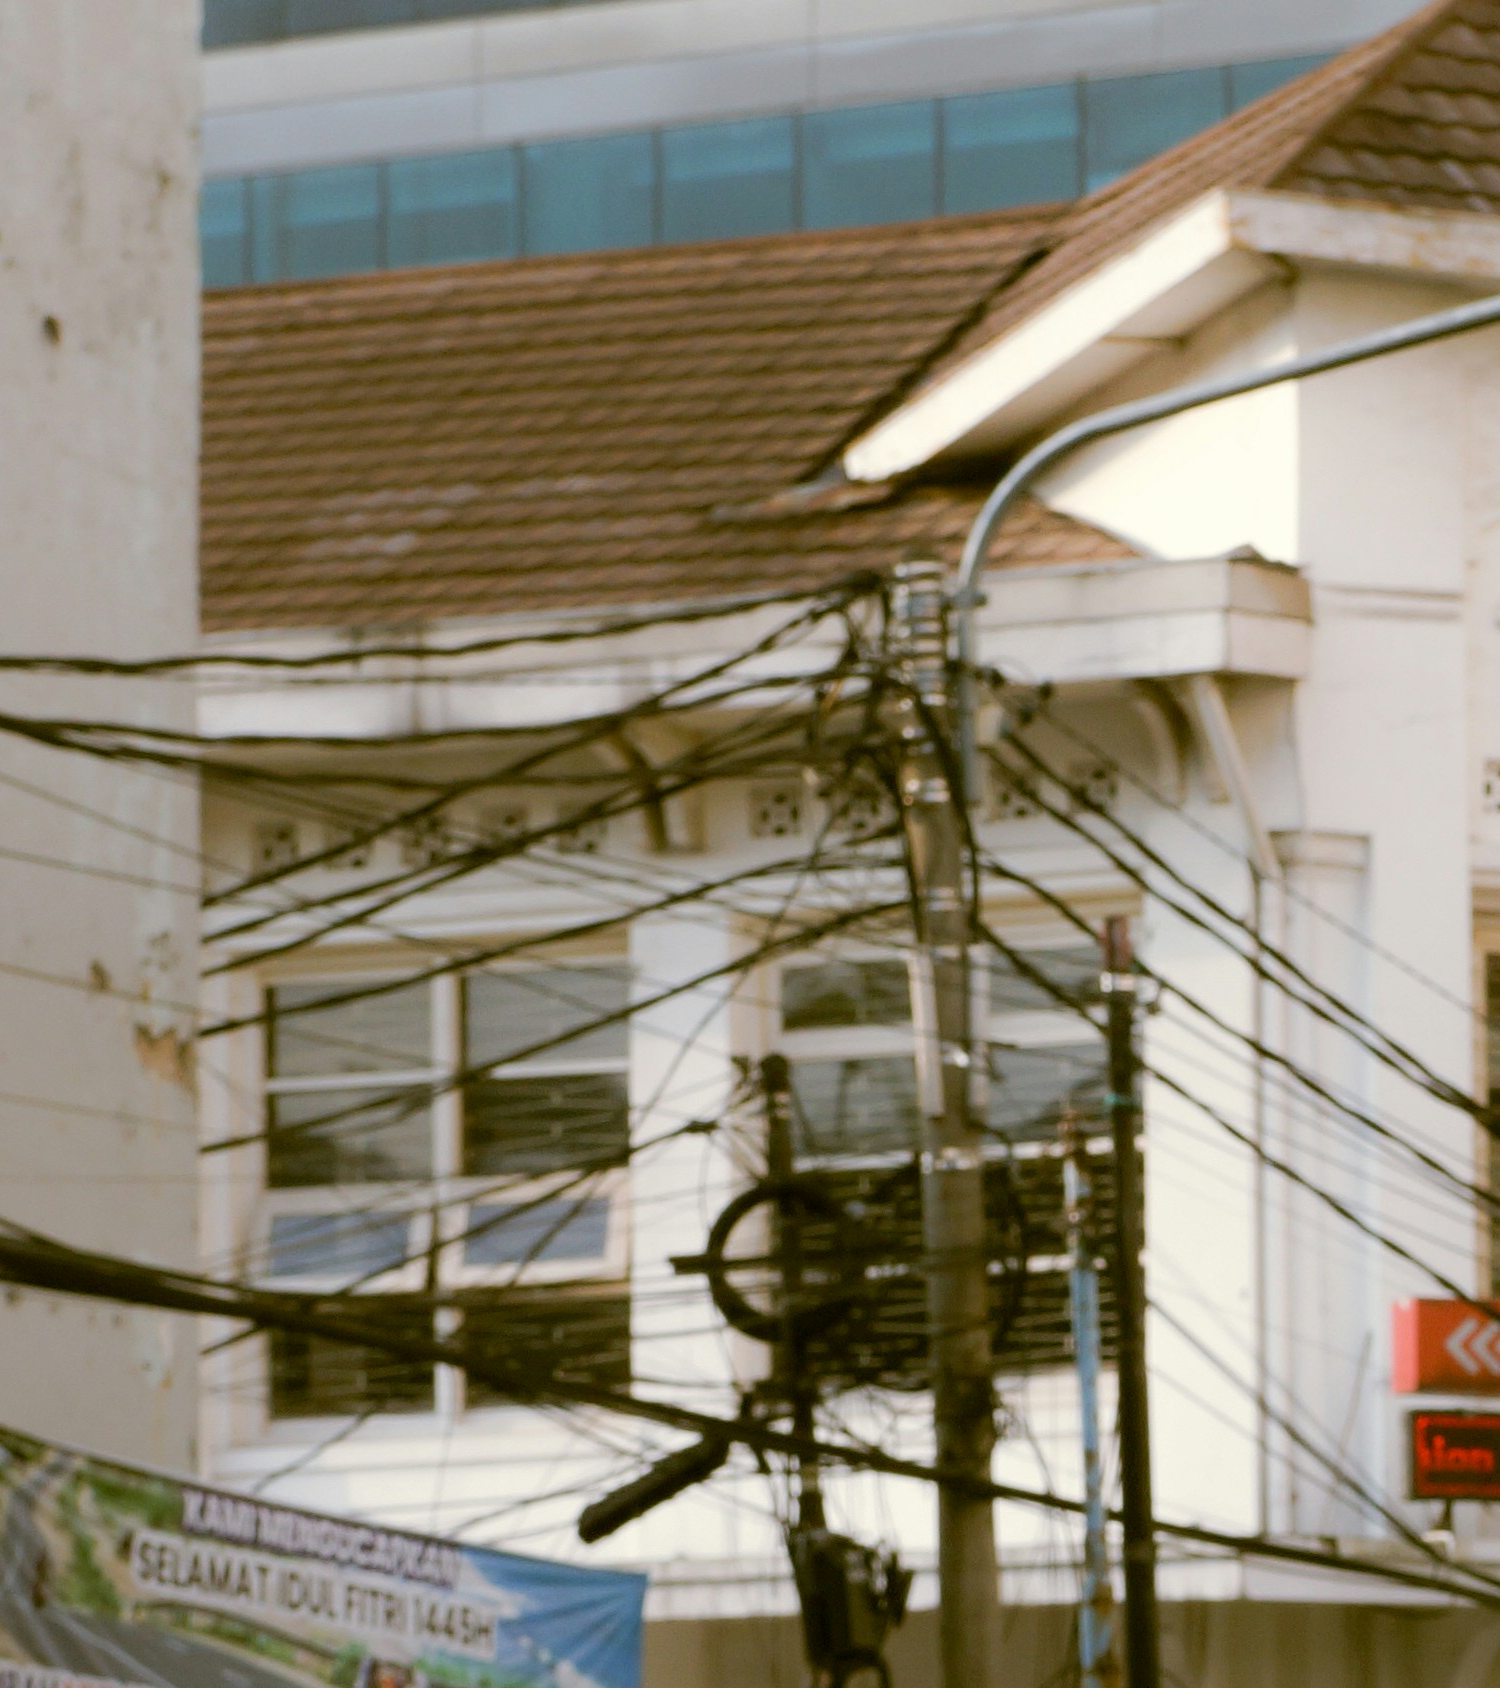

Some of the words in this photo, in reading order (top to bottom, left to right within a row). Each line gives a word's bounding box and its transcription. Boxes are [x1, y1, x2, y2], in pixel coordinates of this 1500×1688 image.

[182, 1489, 255, 1545] KAMI
[139, 1541, 269, 1599] SELAMAT
[279, 1571, 337, 1619] IDUL
[345, 1584, 407, 1635] FITRI
[411, 1595, 493, 1648] 1445H
